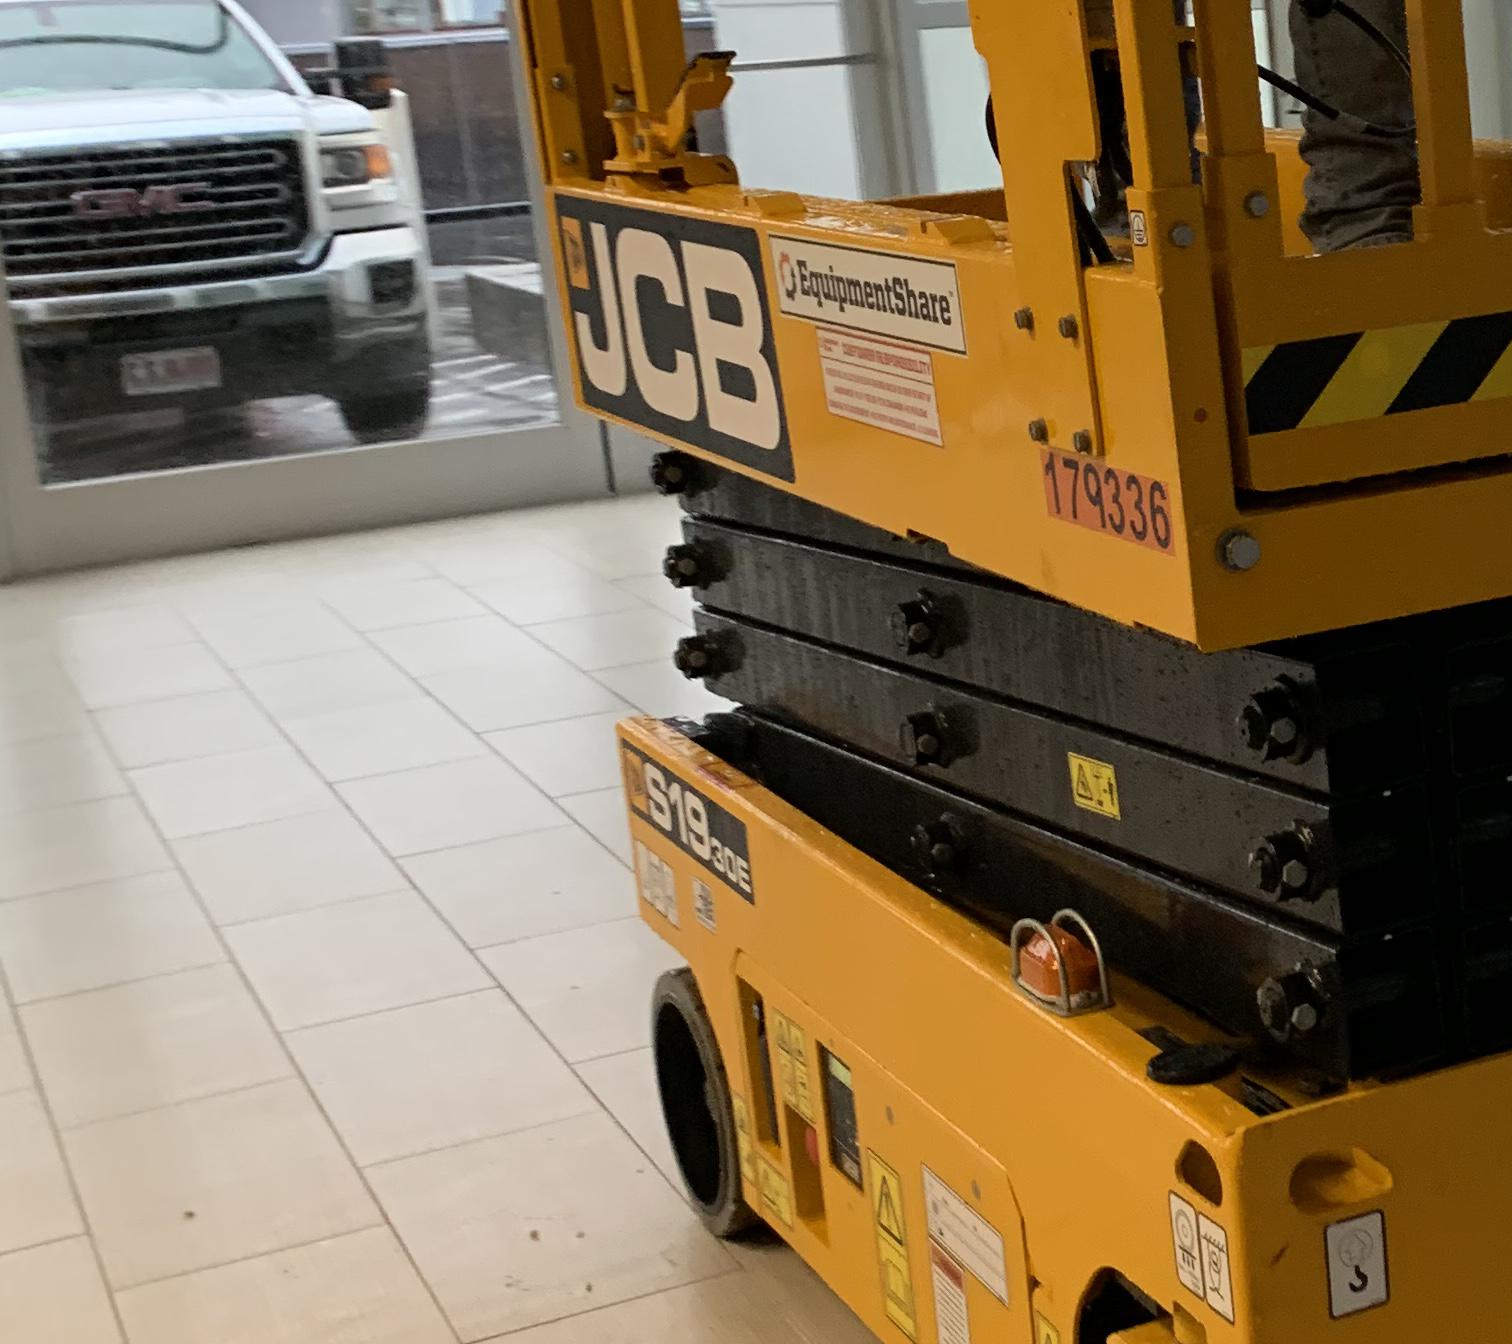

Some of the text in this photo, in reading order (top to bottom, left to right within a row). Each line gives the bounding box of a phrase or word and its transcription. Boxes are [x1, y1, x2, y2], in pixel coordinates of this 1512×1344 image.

[574, 222, 781, 450] JCB
[796, 260, 952, 326] EquipmentShare
[1045, 451, 1171, 549] 179336
